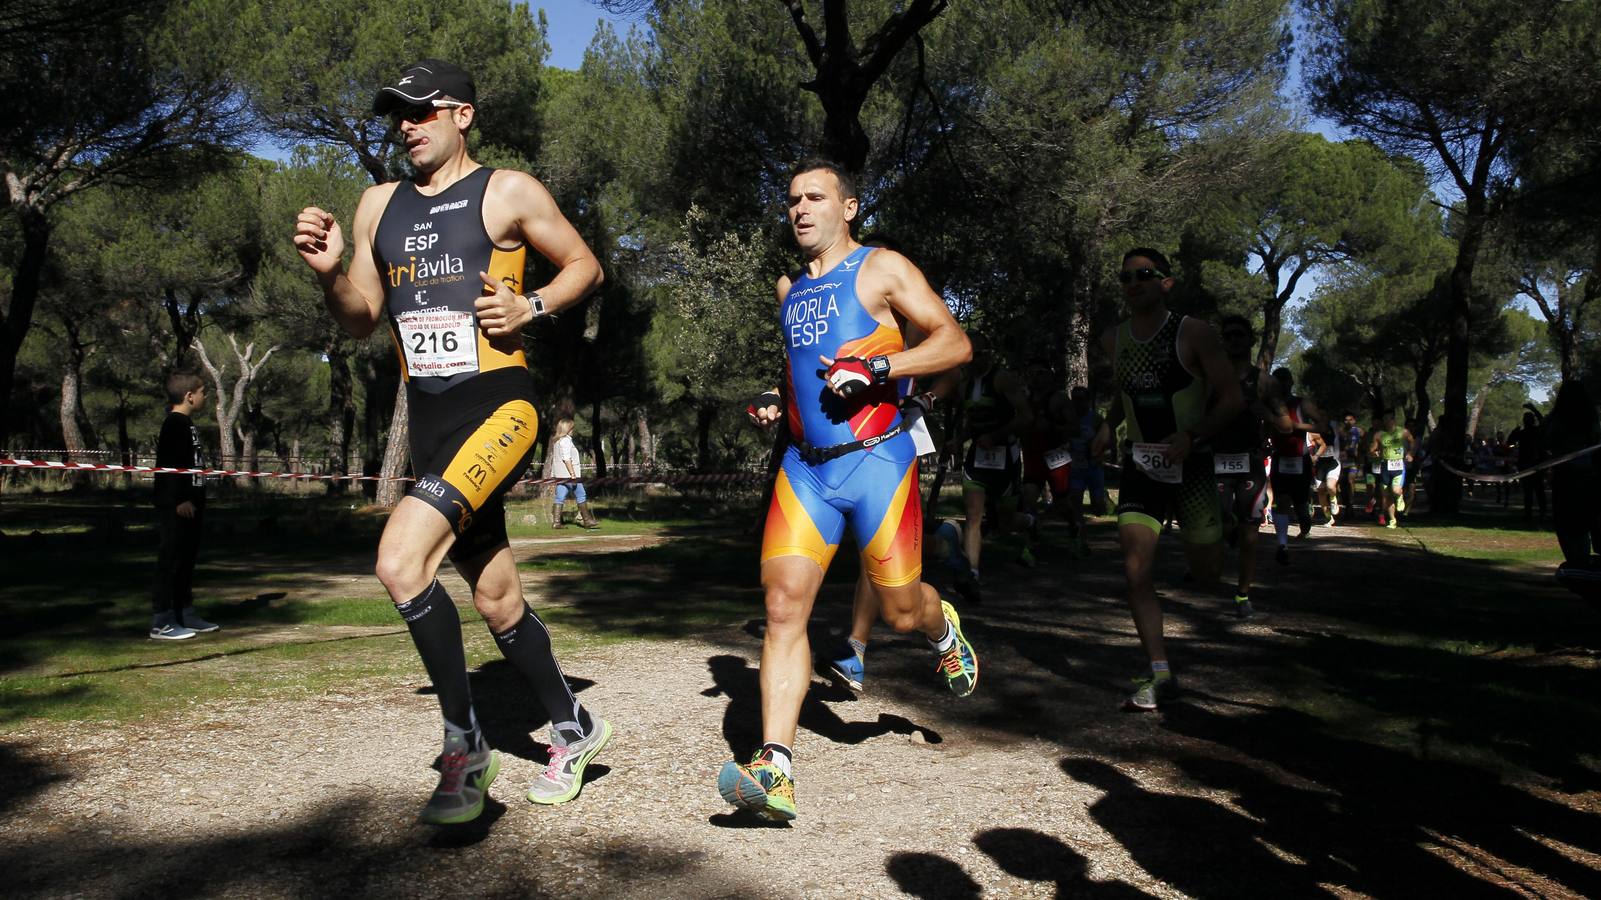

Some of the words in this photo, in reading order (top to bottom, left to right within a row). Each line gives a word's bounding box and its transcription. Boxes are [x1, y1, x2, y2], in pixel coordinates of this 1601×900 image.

[413, 222, 432, 231] SAN
[404, 233, 439, 252] ESP
[785, 294, 840, 326] MORLA
[430, 322, 461, 330] VALLADOLID
[791, 320, 829, 348] ESP
[411, 331, 458, 354] 216
[1142, 455, 1171, 469] 260
[1222, 461, 1243, 470] 155
